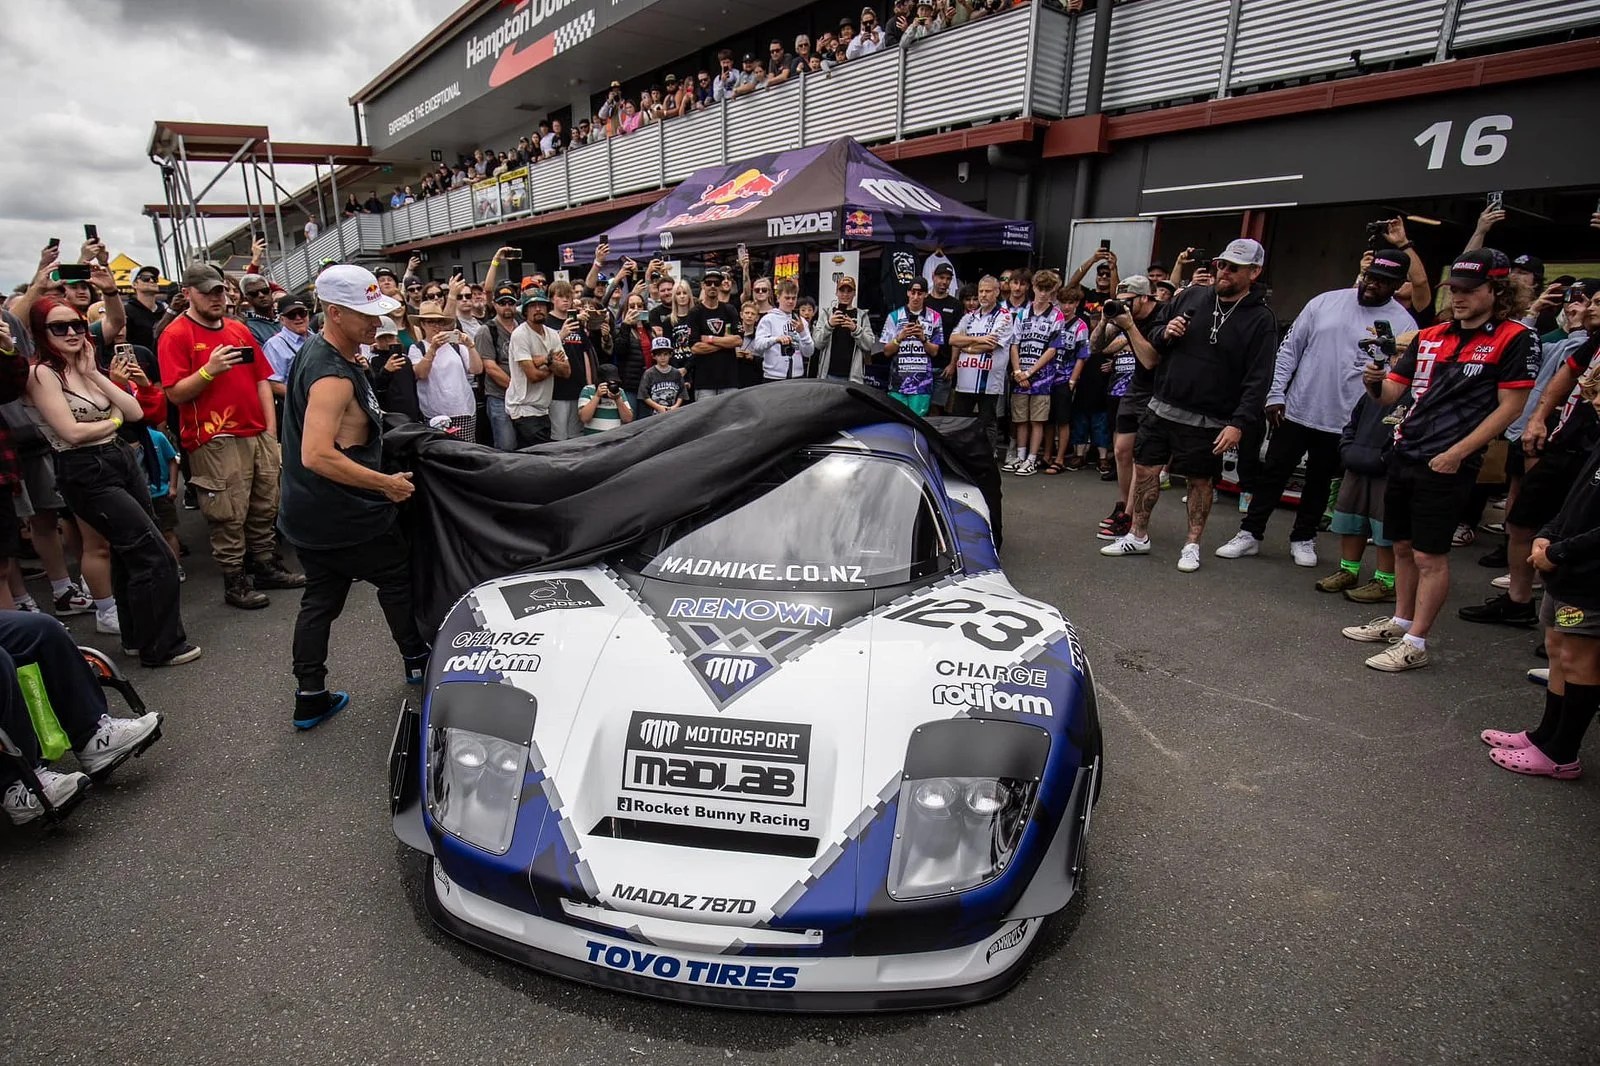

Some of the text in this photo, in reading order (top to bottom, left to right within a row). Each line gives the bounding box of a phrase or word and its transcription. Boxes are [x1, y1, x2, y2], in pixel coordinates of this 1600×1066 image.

[466, 8, 530, 69] Hampton
[1413, 114, 1513, 170] 16
[660, 556, 866, 583] MADMIKE.CO.NZ
[523, 600, 592, 614] PANDEM
[667, 597, 833, 627] RENOWN
[451, 631, 545, 648] CHARGE
[883, 598, 1044, 652] 123
[442, 648, 541, 675] rotiform
[935, 660, 1048, 688] CHARGE
[932, 682, 1054, 717] rotiform
[685, 725, 800, 750] MOTORSPORT
[633, 799, 810, 832] Rocket Bunny Racing
[611, 883, 757, 914] MADAZ 787D
[586, 940, 800, 989] TOYO TIRES
